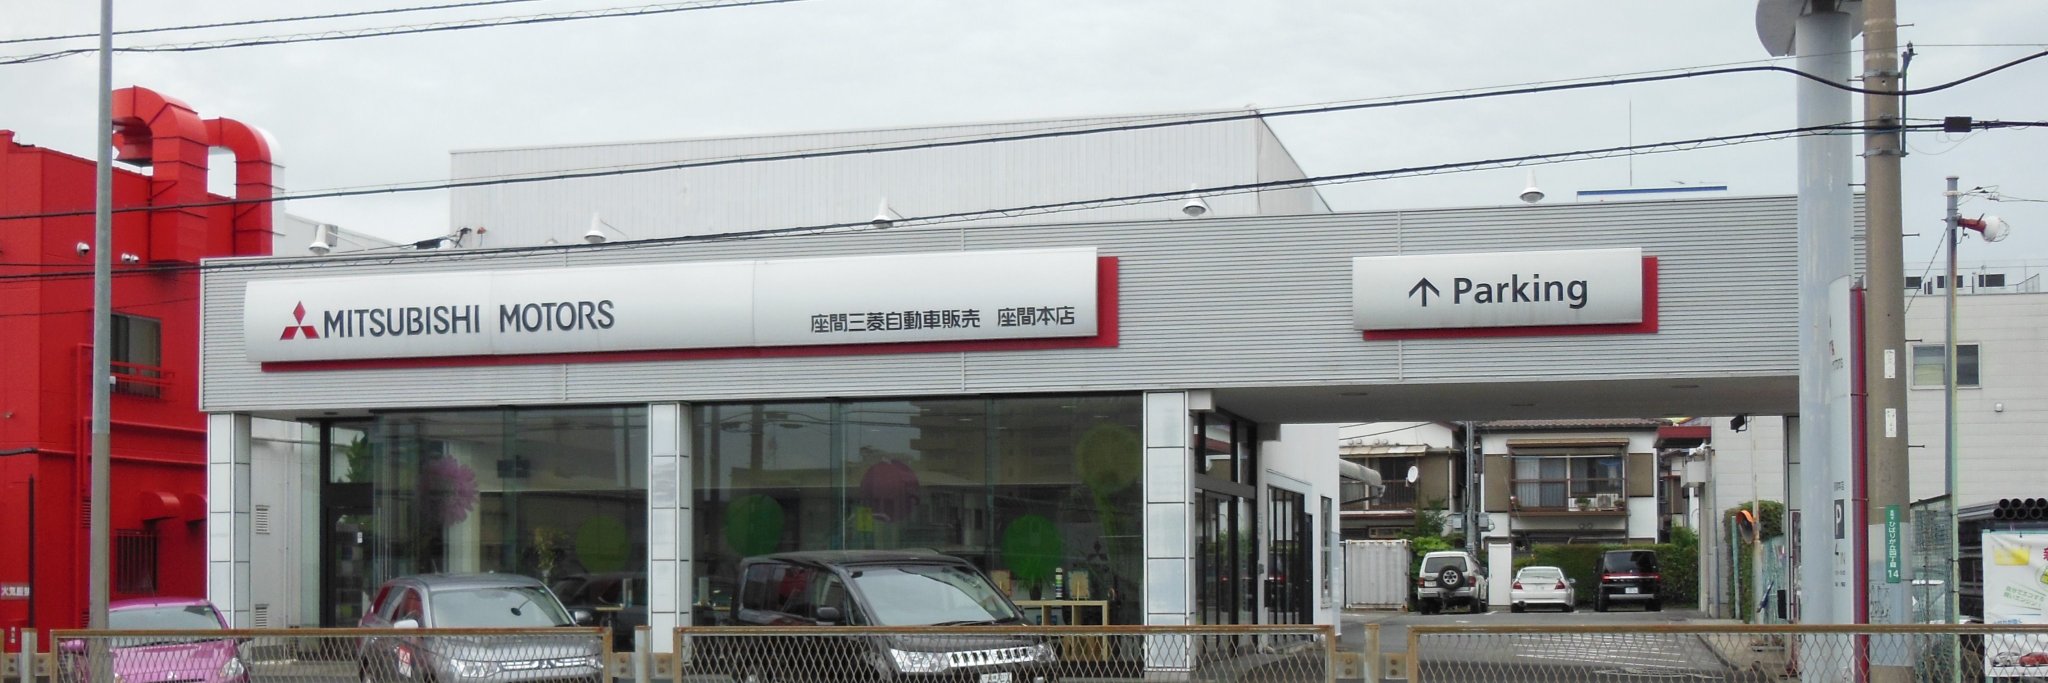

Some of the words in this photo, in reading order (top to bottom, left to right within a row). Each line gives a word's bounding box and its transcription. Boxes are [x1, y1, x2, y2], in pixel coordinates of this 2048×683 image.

[1454, 274, 1587, 309] Parking
[324, 304, 480, 339] MITSUBISHI
[500, 299, 615, 333] MOTORS
[811, 308, 981, 333] 座間三菱自動車販売
[997, 305, 1075, 327] 座間本店
[1887, 569, 1899, 578] 14
